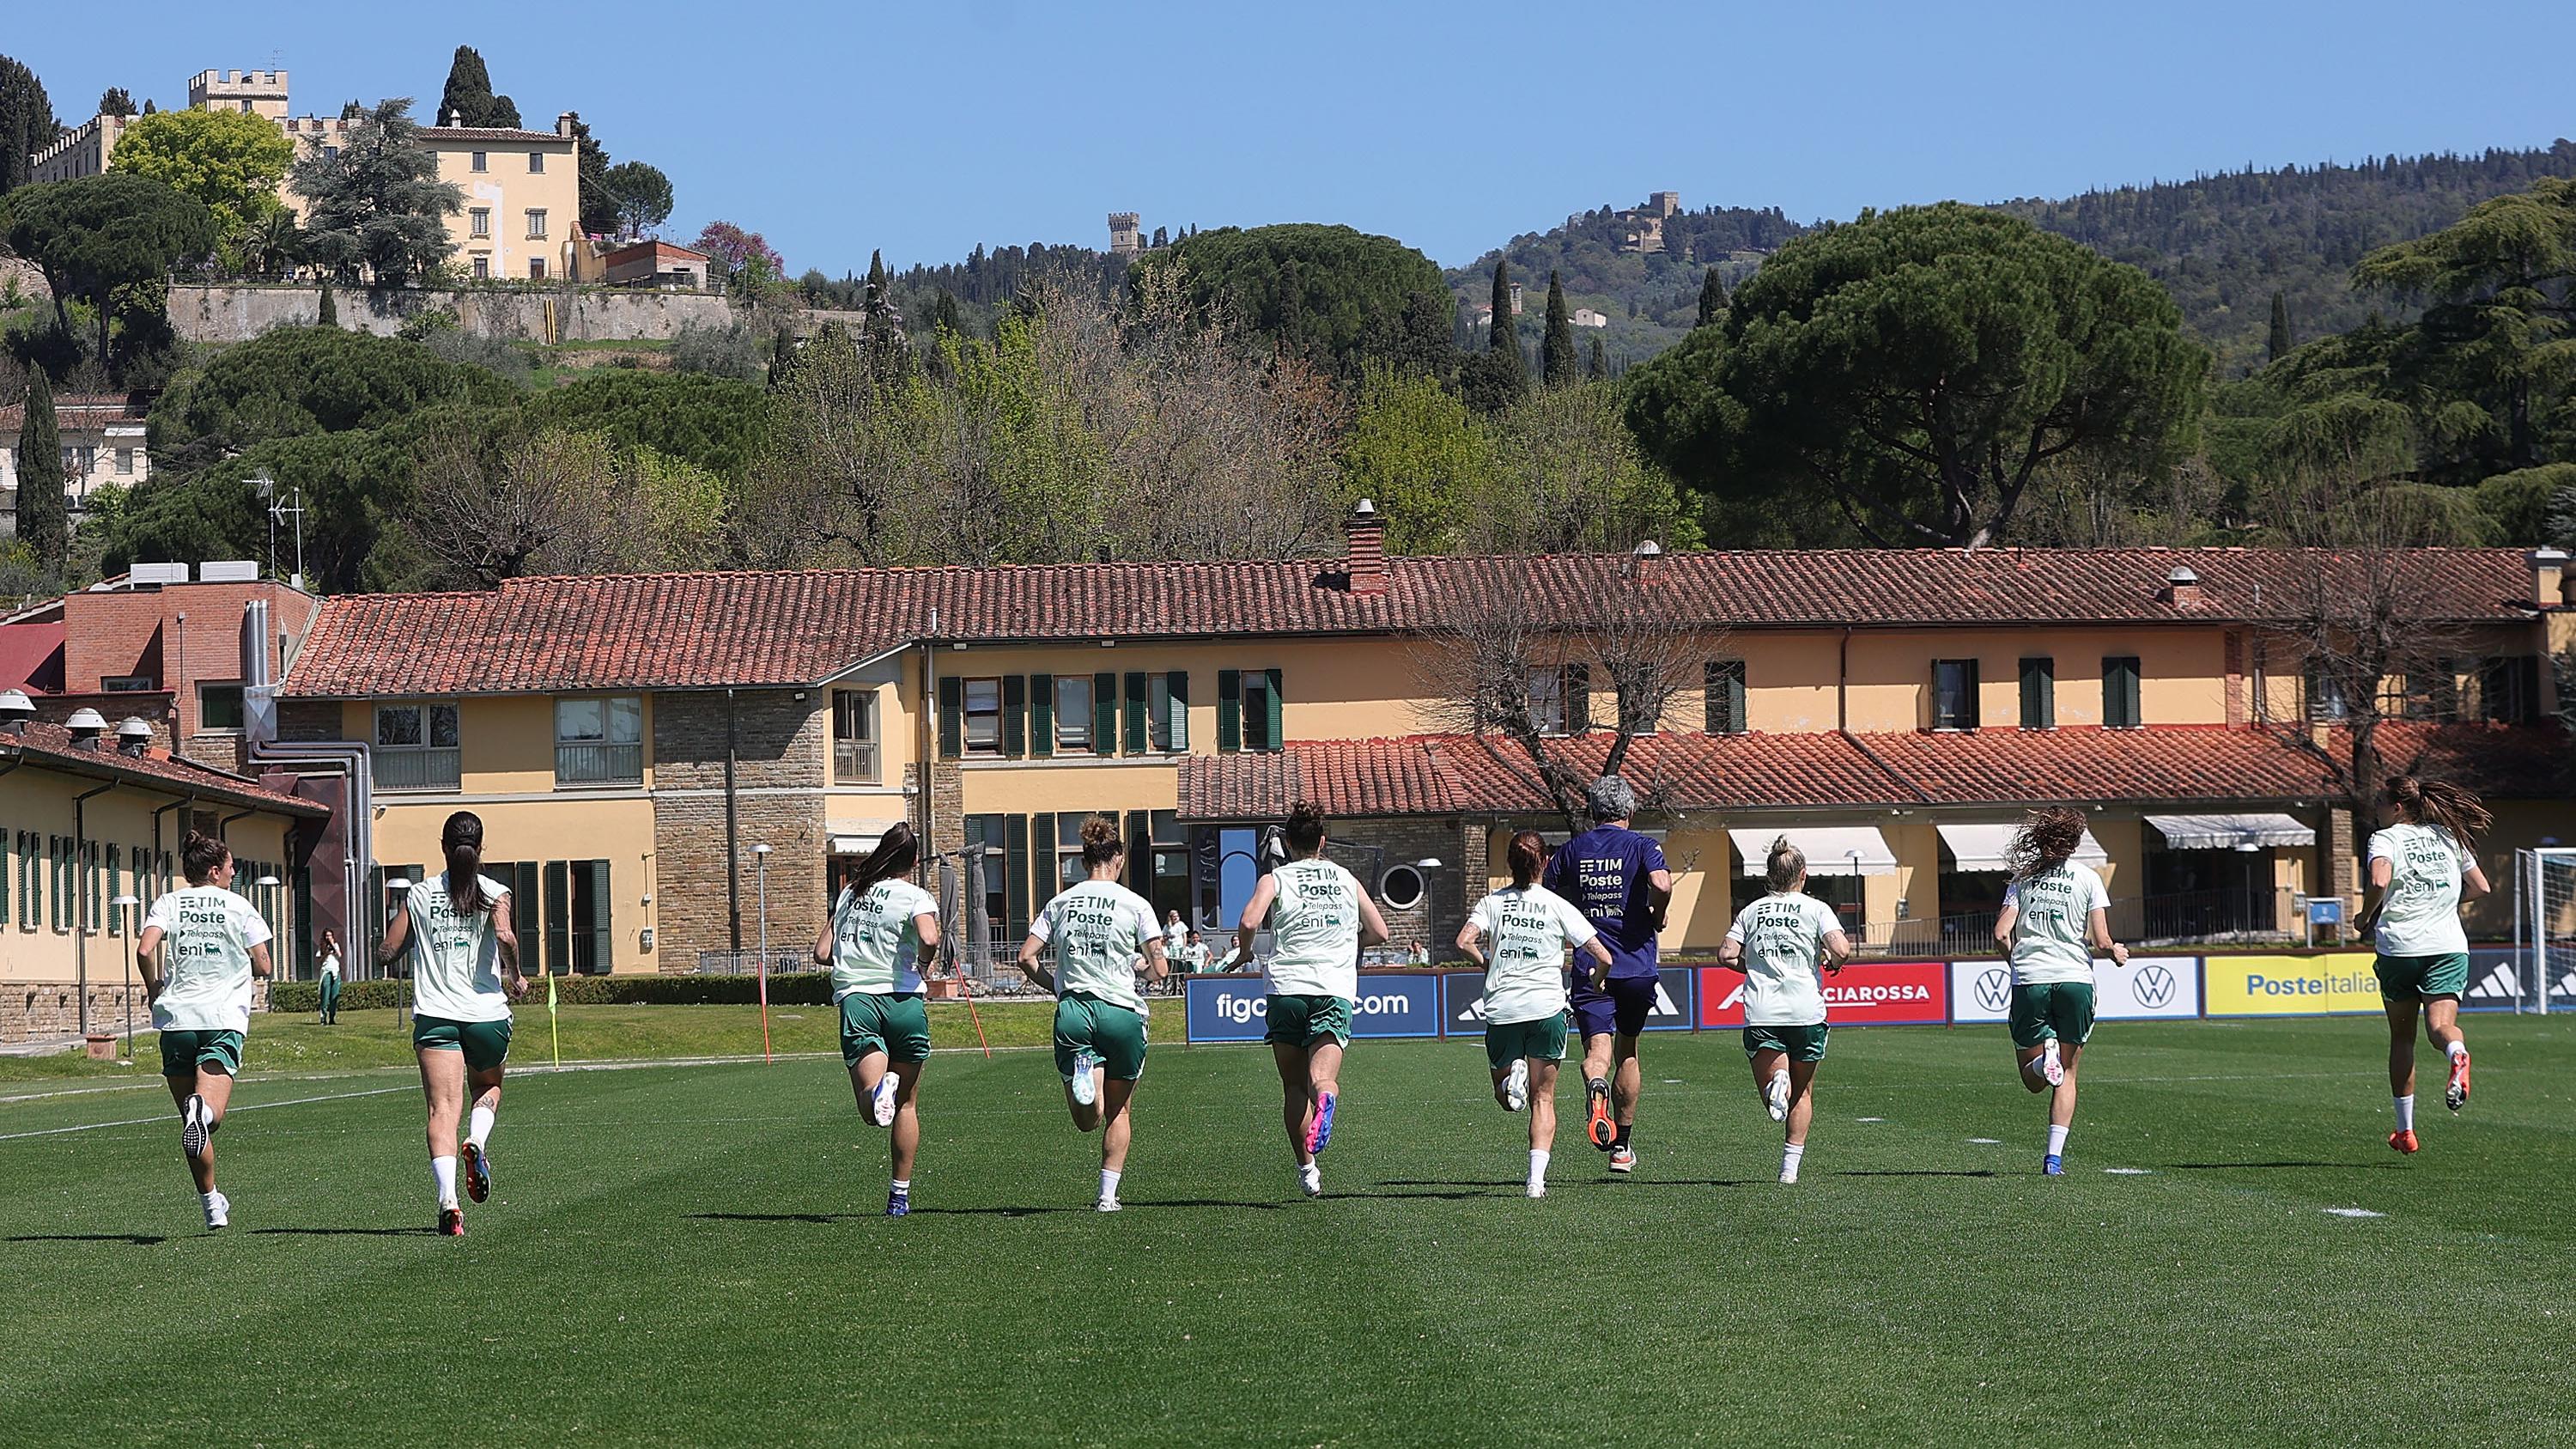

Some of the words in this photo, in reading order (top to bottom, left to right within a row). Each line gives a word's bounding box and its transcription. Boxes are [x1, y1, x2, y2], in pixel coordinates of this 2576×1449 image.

[2408, 851, 2445, 864] Poste
[1596, 859, 1622, 871] TIM
[1313, 868, 1338, 880] TIM
[1580, 874, 1622, 886] Poste
[1298, 884, 1341, 898] Poste
[2032, 880, 2072, 894] Poste
[2415, 880, 2434, 892] eni
[870, 886, 890, 900] IM
[1587, 892, 1622, 901] Telepass
[198, 897, 226, 908] TIM
[1088, 896, 1115, 910] TIM
[1309, 902, 1342, 910] Telepass
[1520, 900, 1546, 915] TIM
[2037, 896, 2069, 907] Telepass
[430, 906, 474, 919] Pose
[1583, 904, 1603, 917] eni
[1774, 903, 1801, 914] TIM
[2028, 909, 2049, 921] eni
[179, 910, 225, 923] Poste
[1067, 910, 1113, 926] Poste
[1302, 915, 1322, 928] eni
[1502, 914, 1545, 930] Poste
[1757, 916, 1799, 928] Poste
[186, 929, 224, 939] Telepass
[1073, 929, 1109, 941] Telepass
[1507, 933, 1542, 944] Telepass
[179, 942, 203, 956] eni
[434, 937, 453, 952] eni
[1067, 943, 1089, 956] eni
[1500, 947, 1521, 959] eni
[1758, 945, 1778, 958] eni
[1821, 985, 1930, 1002] CIAROSSA
[1216, 993, 1267, 1023] figc
